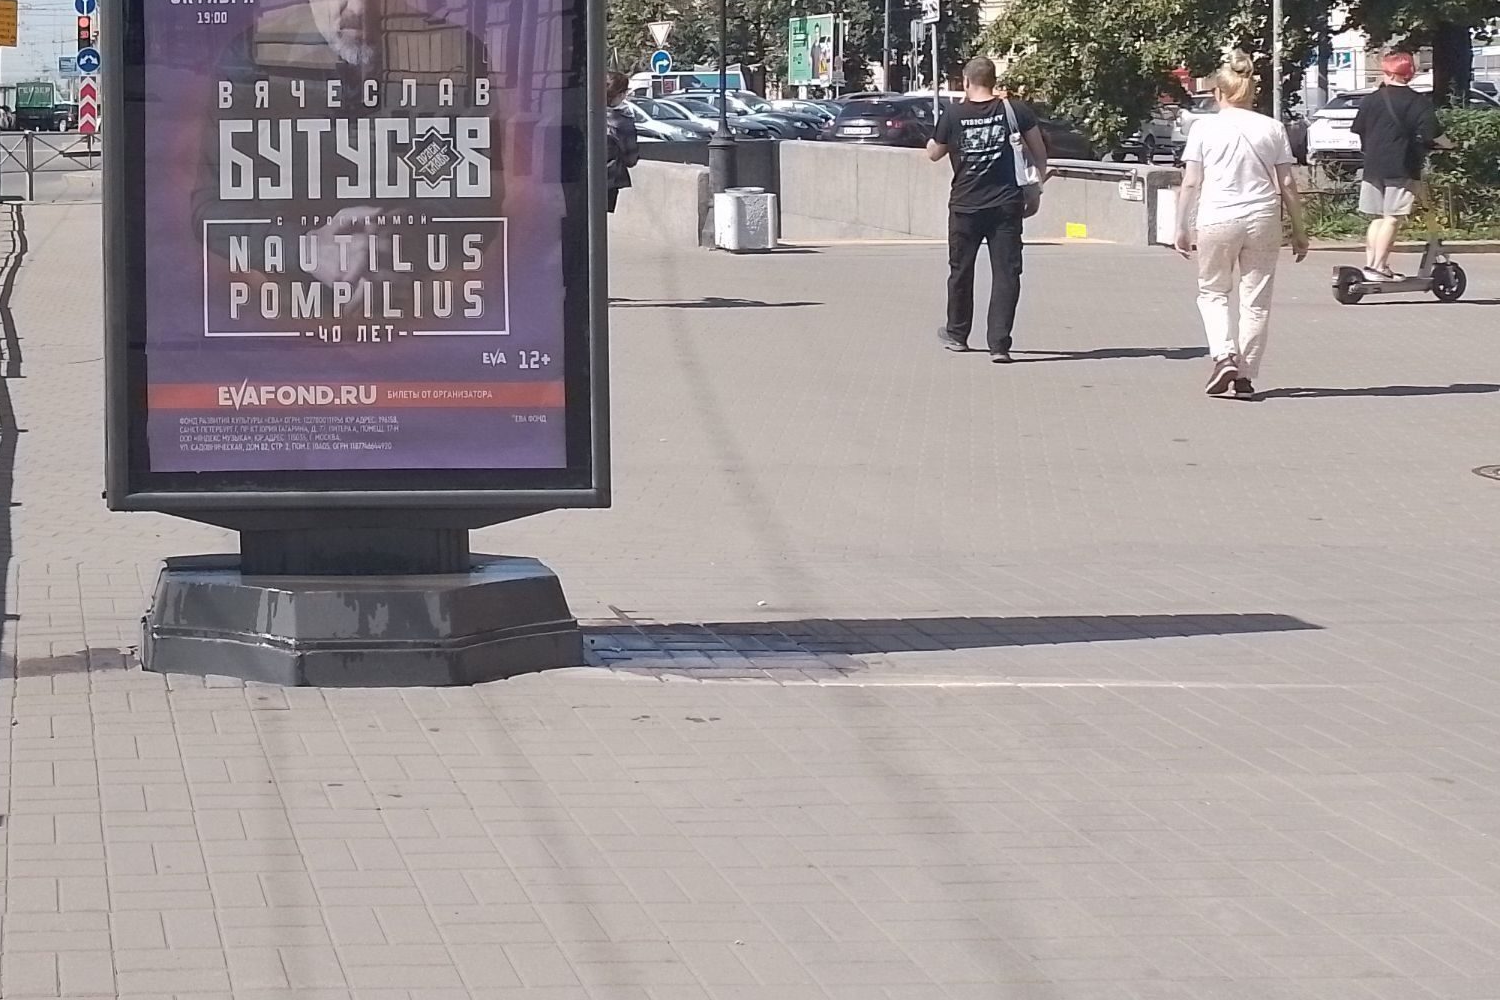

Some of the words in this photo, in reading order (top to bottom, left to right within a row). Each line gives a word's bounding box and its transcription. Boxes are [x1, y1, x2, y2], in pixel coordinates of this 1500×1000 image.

[196, 11, 228, 24] 19:00
[218, 78, 490, 109] ВЯЧЕСЛАВ
[219, 116, 491, 200] БУТУСОВ
[276, 216, 283, 226] С
[301, 213, 428, 226] ПРОГРАММОЙ
[229, 233, 484, 273] NAUTILUS
[230, 280, 484, 320] POMPILIUS
[482, 348, 507, 367] EVA
[519, 350, 551, 369] 12+
[218, 378, 377, 411] EVAFOND.RU
[387, 390, 419, 399] БИЛЕТЫ
[421, 390, 431, 399] ОТ
[433, 390, 493, 399] ОРГАНИЗАТОРА
[180, 417, 198, 425] ФОНД
[231, 416, 263, 424] КУЛЬТУРЫ
[180, 434, 192, 442] ООО
[246, 443, 260, 451] ДОМ
